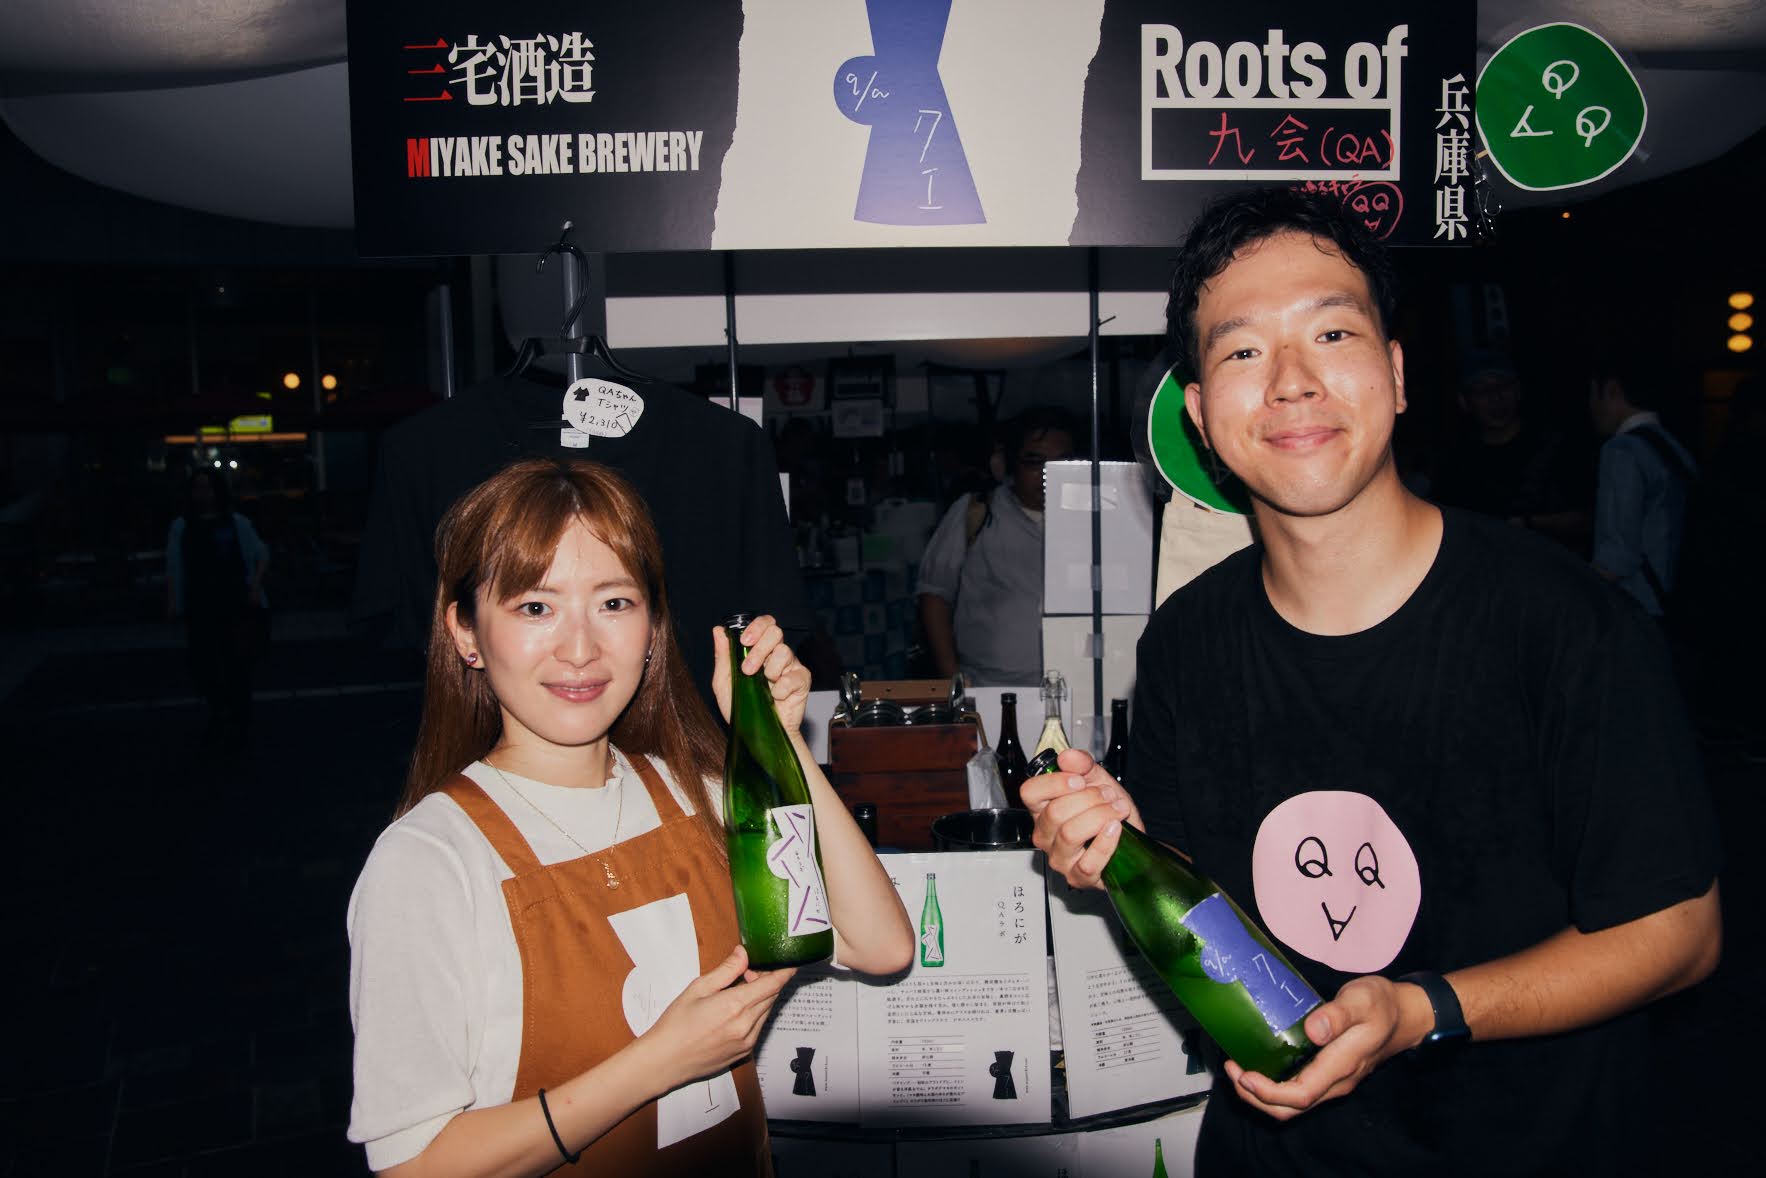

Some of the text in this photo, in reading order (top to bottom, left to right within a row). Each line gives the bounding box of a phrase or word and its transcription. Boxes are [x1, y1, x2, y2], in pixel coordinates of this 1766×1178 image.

[403, 32, 596, 107] 三宅酒造
[1141, 23, 1408, 99] Roots of
[407, 131, 704, 178] MIYAKE SAKE BREWERY
[1434, 73, 1472, 241] 兵庫県
[1013, 885, 1027, 944] ほろにが
